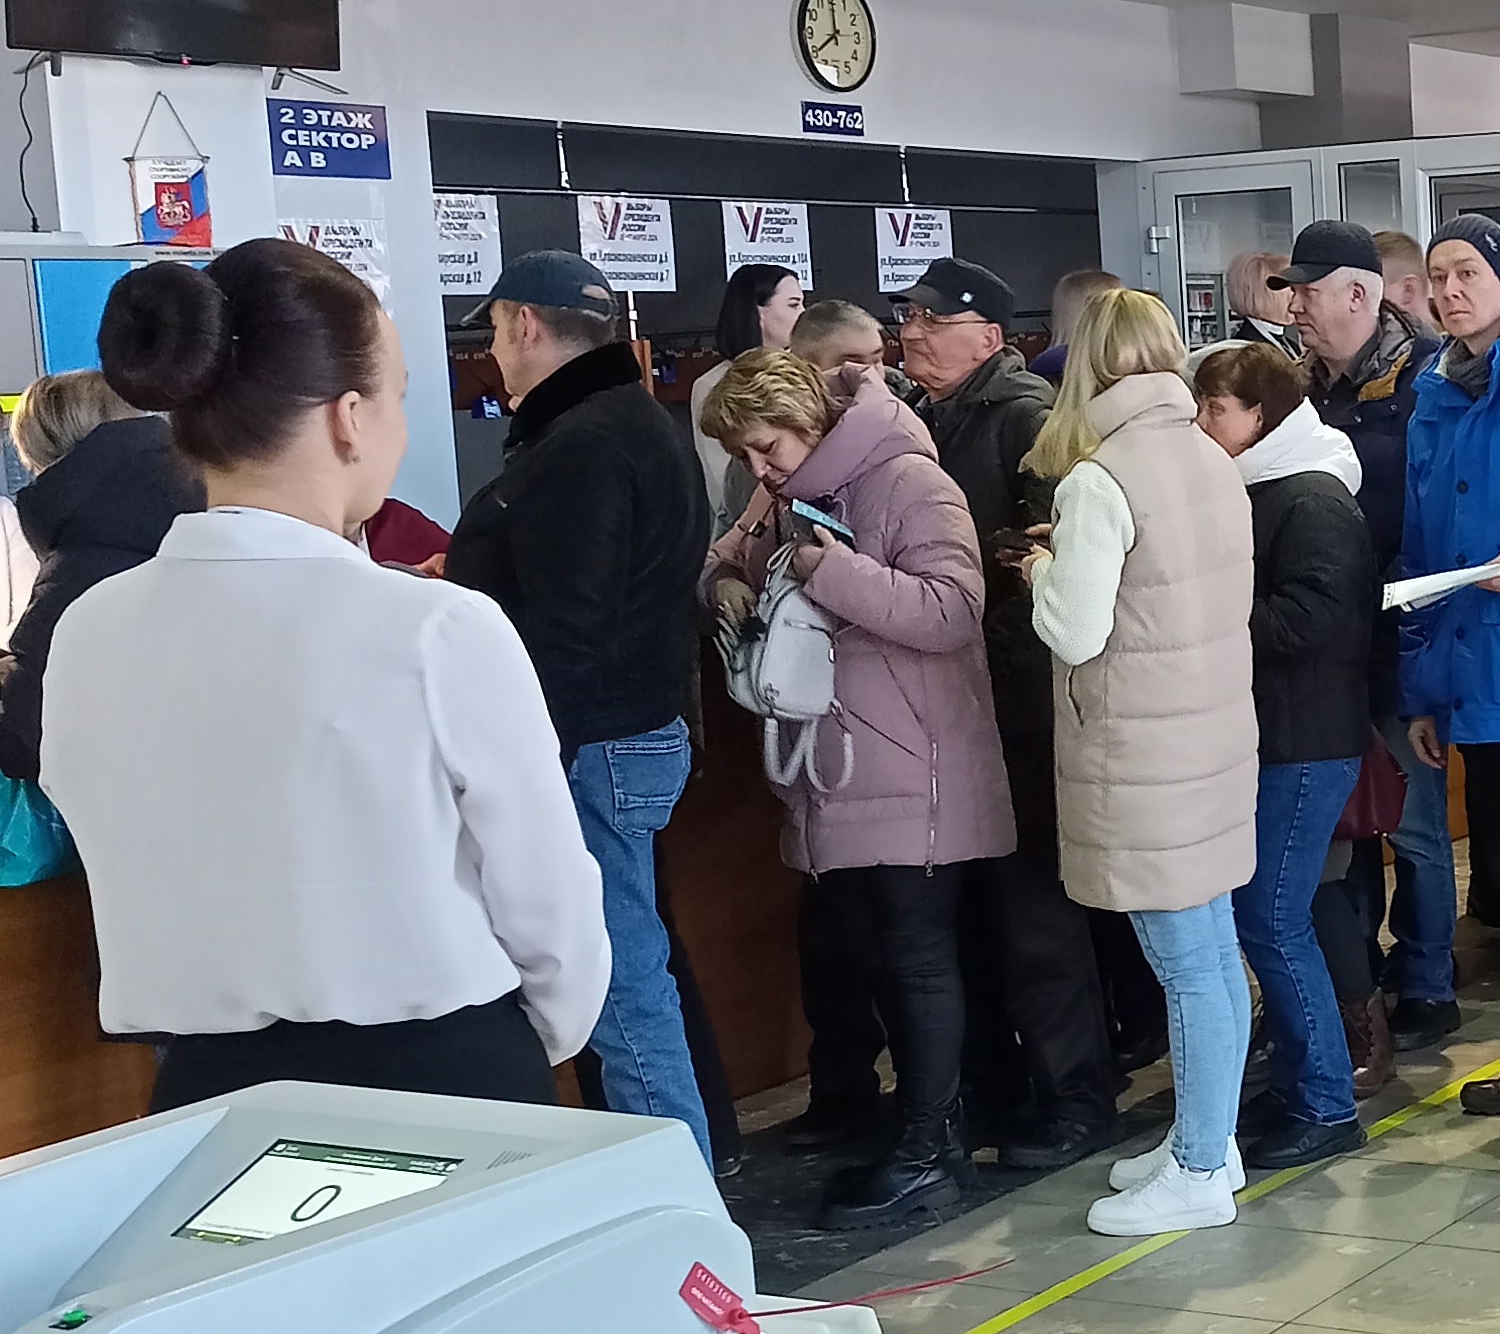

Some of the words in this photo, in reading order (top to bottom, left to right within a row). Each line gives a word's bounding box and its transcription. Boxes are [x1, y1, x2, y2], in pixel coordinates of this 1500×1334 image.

[842, 0, 846, 12] 1
[806, 8, 818, 22] 10
[849, 13, 857, 26] 2
[806, 26, 814, 39] 9
[853, 32, 861, 45] 3
[850, 49, 859, 61] 4
[843, 61, 852, 74] 5
[279, 108, 295, 124] 2
[302, 108, 374, 129] ЭТАЖ
[281, 128, 376, 149] СЕКТОР
[283, 150, 303, 167] А
[310, 151, 327, 168] В
[290, 1184, 341, 1222] 0
